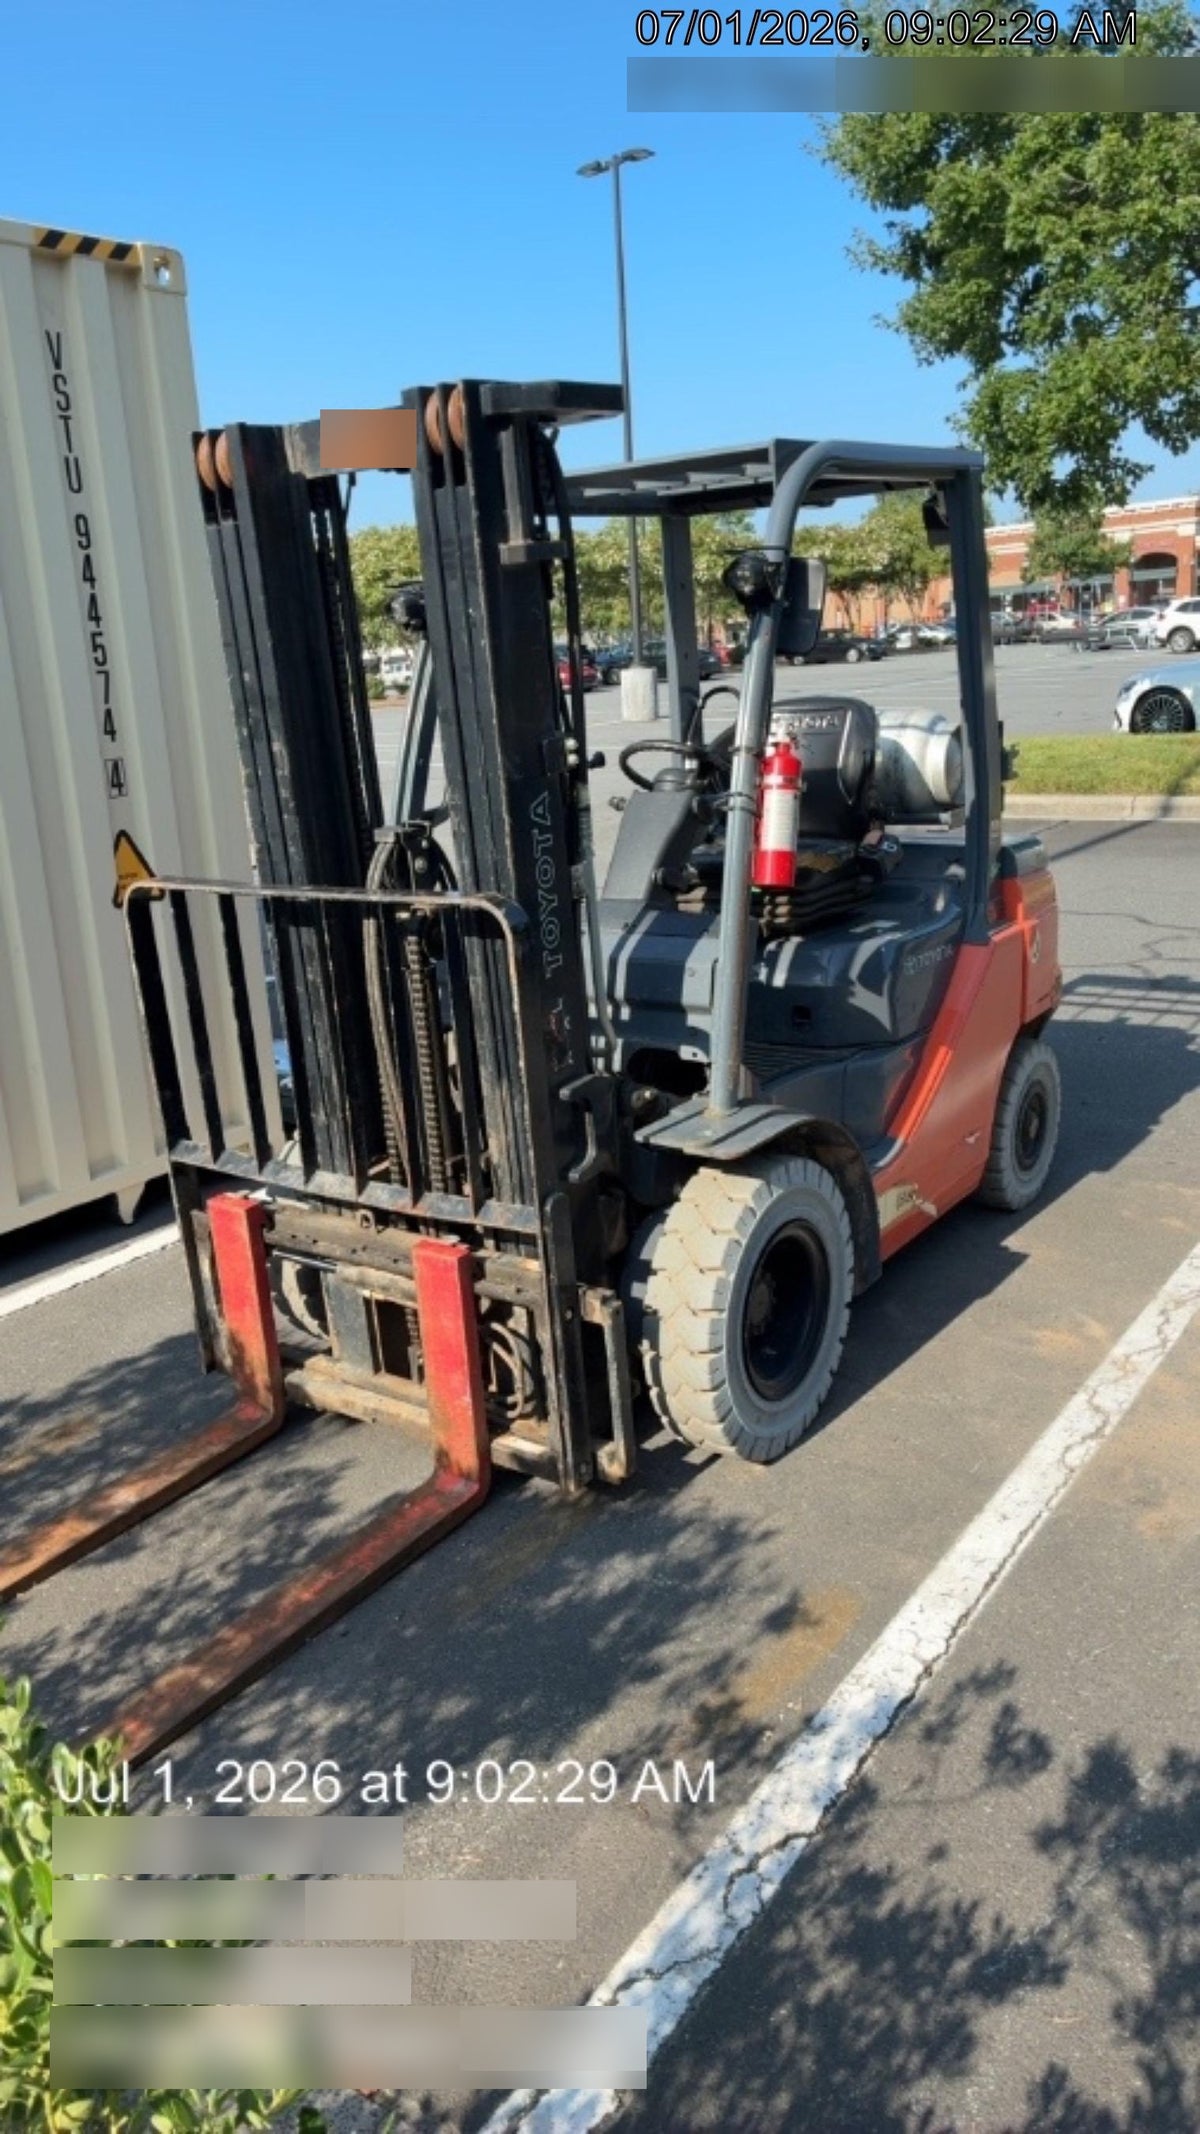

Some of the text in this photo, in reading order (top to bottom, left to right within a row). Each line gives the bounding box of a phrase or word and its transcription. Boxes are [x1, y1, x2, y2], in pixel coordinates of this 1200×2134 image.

[45, 329, 83, 494] VSTU
[75, 513, 117, 743] 944574
[530, 791, 562, 979] TOYOTA
